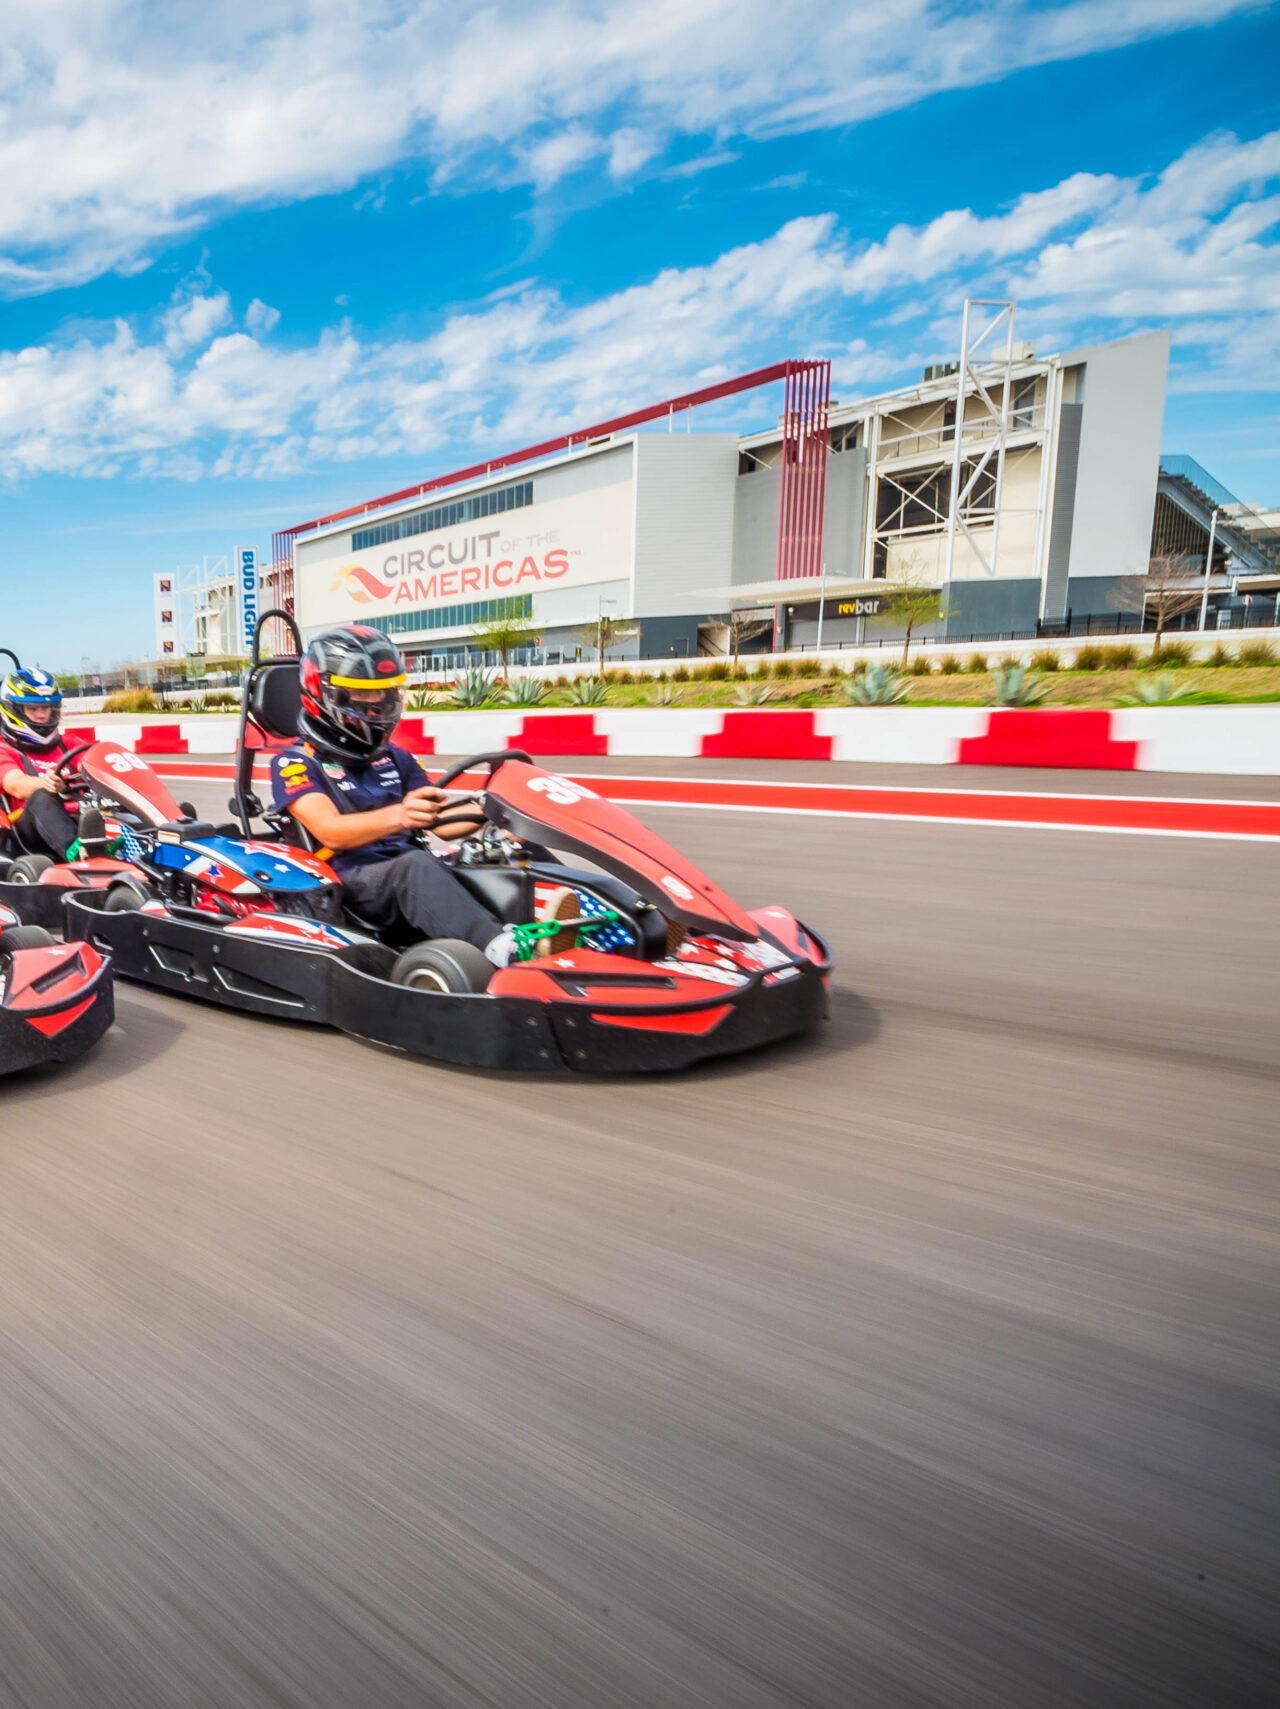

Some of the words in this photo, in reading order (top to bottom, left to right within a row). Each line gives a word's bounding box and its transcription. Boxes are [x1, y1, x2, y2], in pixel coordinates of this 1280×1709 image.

[242, 551, 255, 591] BUD
[383, 530, 500, 578] CIRCUIT
[500, 538, 523, 554] OF
[526, 529, 561, 547] THE
[395, 549, 569, 604] AMERICAS
[838, 599, 880, 615] revbar
